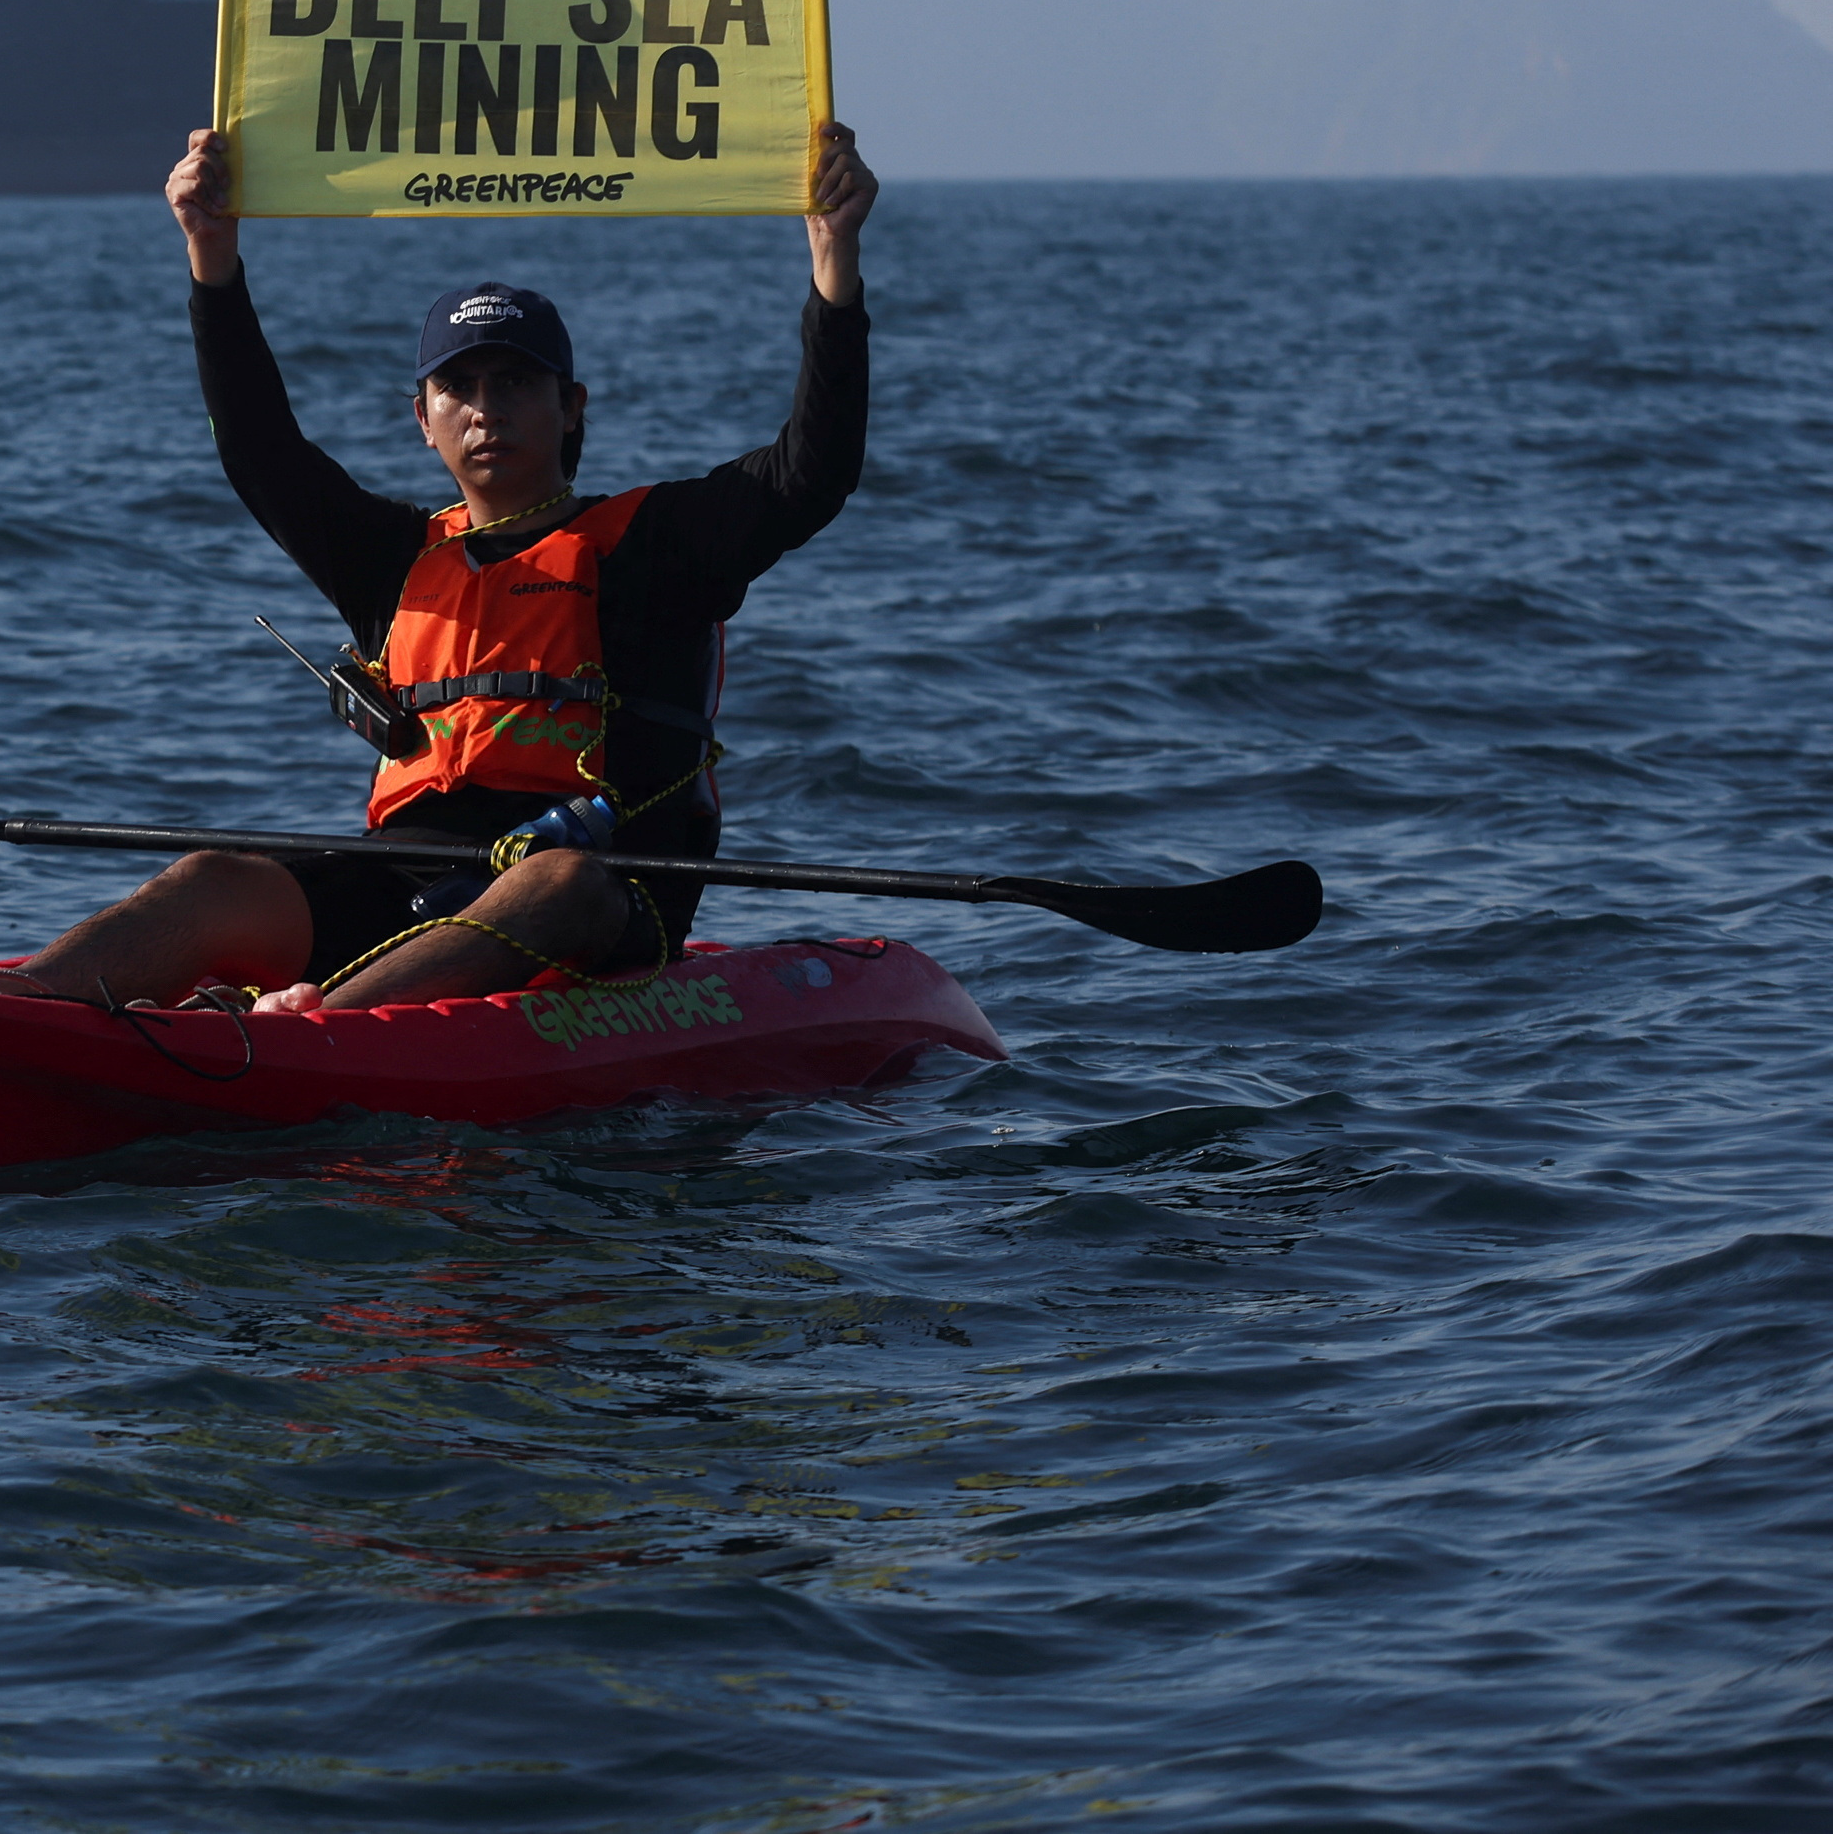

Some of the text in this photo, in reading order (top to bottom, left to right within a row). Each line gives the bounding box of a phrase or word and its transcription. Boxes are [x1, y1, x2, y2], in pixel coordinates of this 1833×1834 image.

[315, 40, 720, 160] MINING
[404, 172, 634, 207] GREENPEACE
[520, 974, 743, 1052] GREENPEACE
